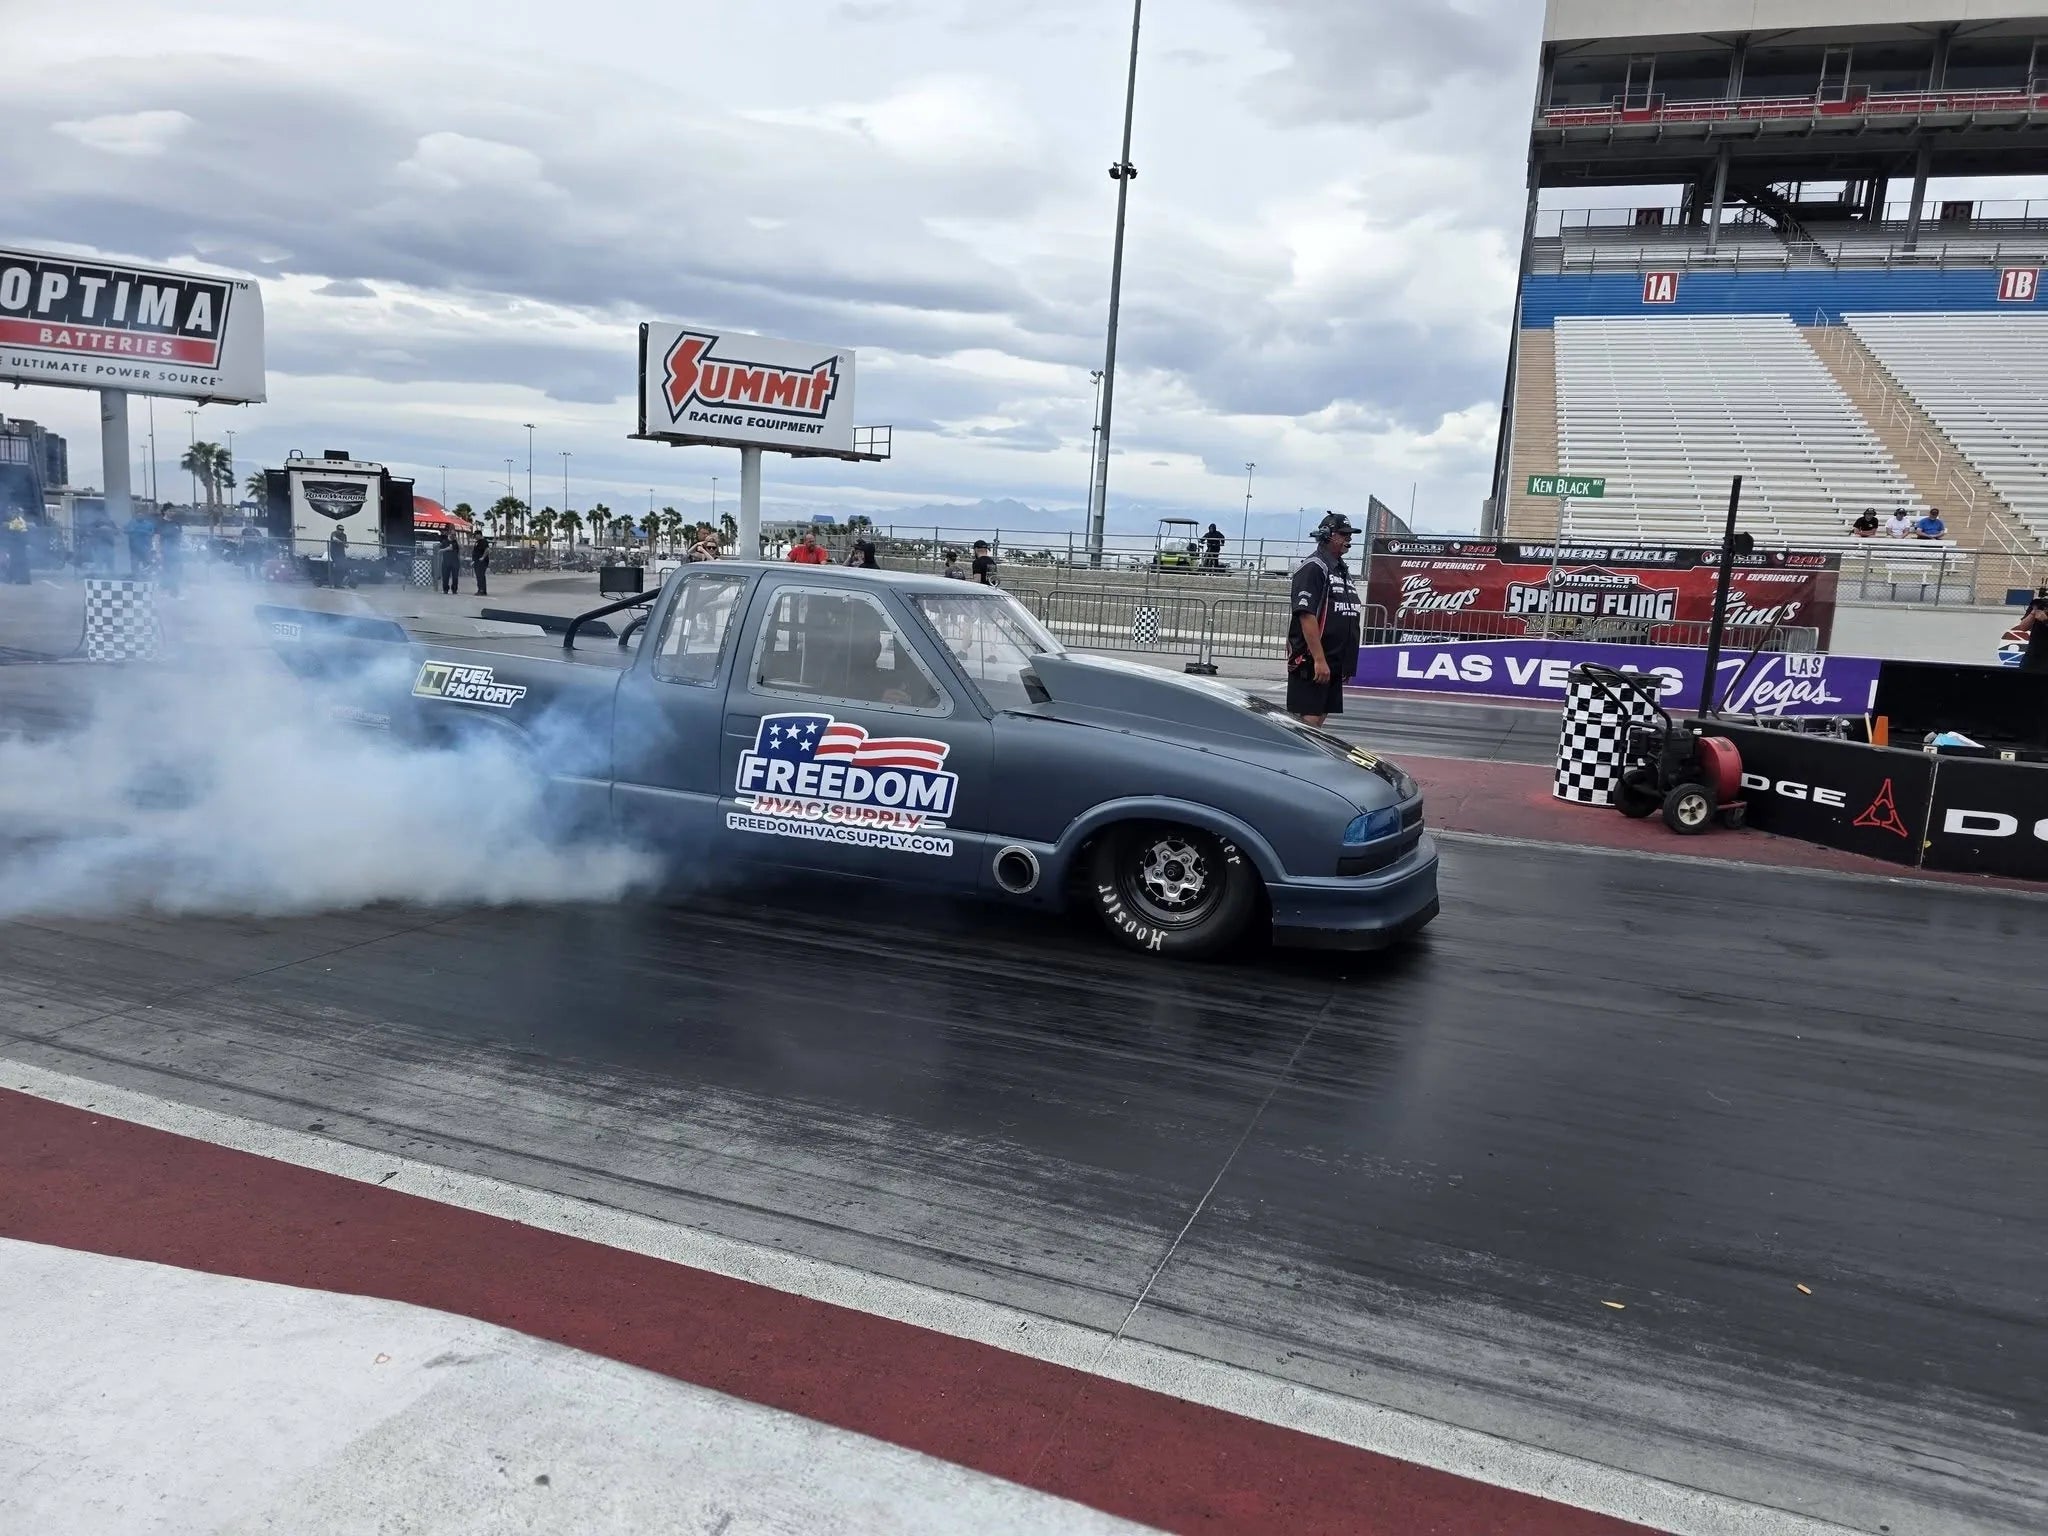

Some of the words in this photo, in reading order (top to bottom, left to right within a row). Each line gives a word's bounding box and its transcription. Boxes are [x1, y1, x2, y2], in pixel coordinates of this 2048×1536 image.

[1649, 276, 1671, 300] 1A
[2005, 272, 2033, 297] 1B
[0, 267, 213, 333] OPTIMA
[40, 328, 173, 356] BATTERIES
[12, 357, 88, 373] ULTIMATE
[96, 365, 150, 380] POWER
[689, 411, 743, 426] RACING
[747, 417, 824, 434] EQUIPMENT
[1532, 478, 1552, 493] KEN
[1556, 479, 1590, 495] BLACK
[1519, 545, 1608, 561] WINNERS
[1610, 549, 1678, 562] CIRCLE
[1401, 560, 1420, 568] RACE
[1420, 561, 1430, 569] IT
[1432, 562, 1476, 571] EXPERIENCE
[1476, 563, 1486, 571] IT
[1401, 574, 1432, 592] The
[1566, 574, 1638, 585] MOSER
[1733, 573, 1745, 581] IT
[1747, 574, 1798, 583] EXPERIENCE
[1398, 587, 1480, 618] Flings
[1509, 586, 1597, 613] SPRING
[1602, 593, 1673, 620] FLING
[451, 667, 490, 685] FUEL
[1397, 651, 1493, 682] LAS
[1788, 655, 1822, 675] LAS
[445, 682, 518, 704] FACTORY
[1716, 656, 1842, 716] Vegas
[742, 756, 949, 811] FREEDOM
[756, 795, 822, 819] HVAC
[827, 804, 924, 830] SUPPLY
[728, 816, 951, 854] FREEDOMHVACSUPPLY.COM
